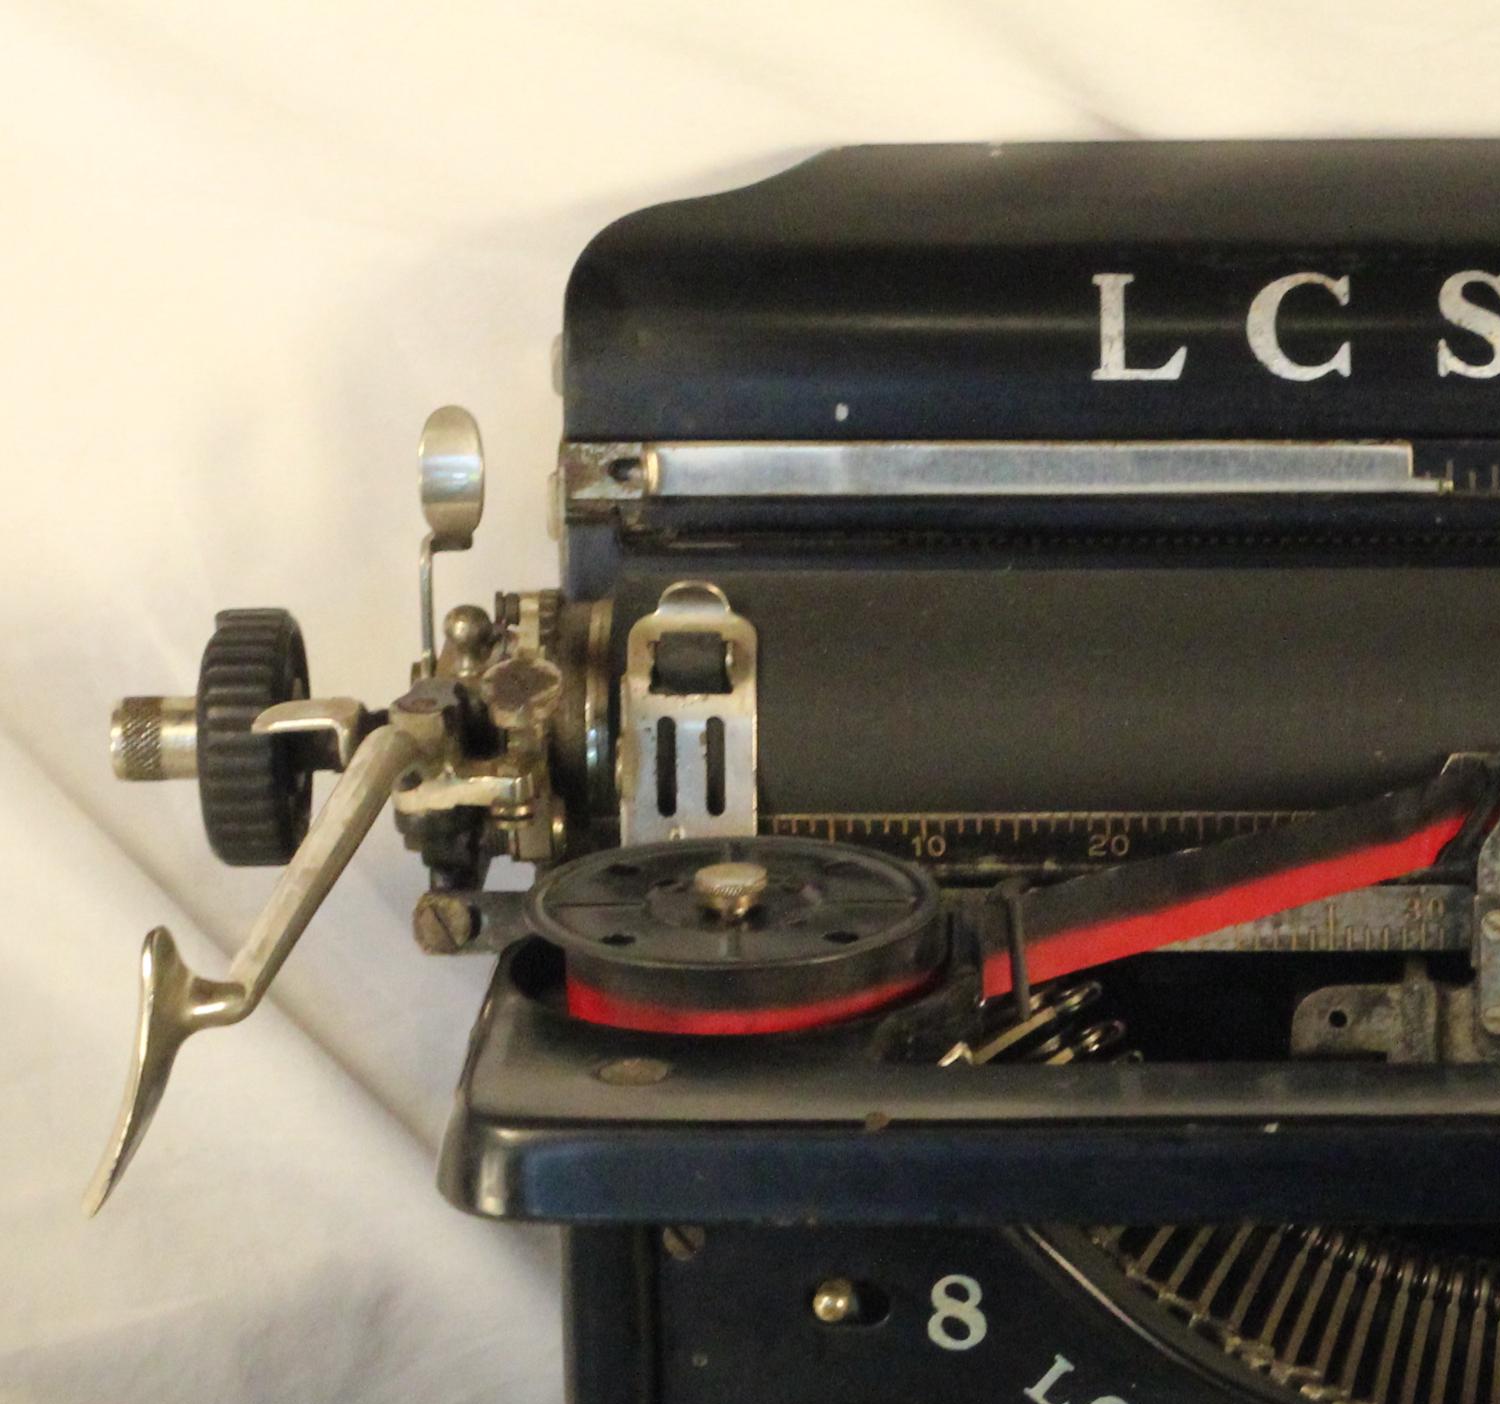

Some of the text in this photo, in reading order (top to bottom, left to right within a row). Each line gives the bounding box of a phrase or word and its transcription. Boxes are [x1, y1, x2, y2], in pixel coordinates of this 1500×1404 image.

[1091, 273, 1188, 382] L
[1245, 273, 1352, 382] C
[912, 836, 946, 857] 10
[1088, 835, 1129, 857] 20
[927, 1274, 988, 1351] 8
